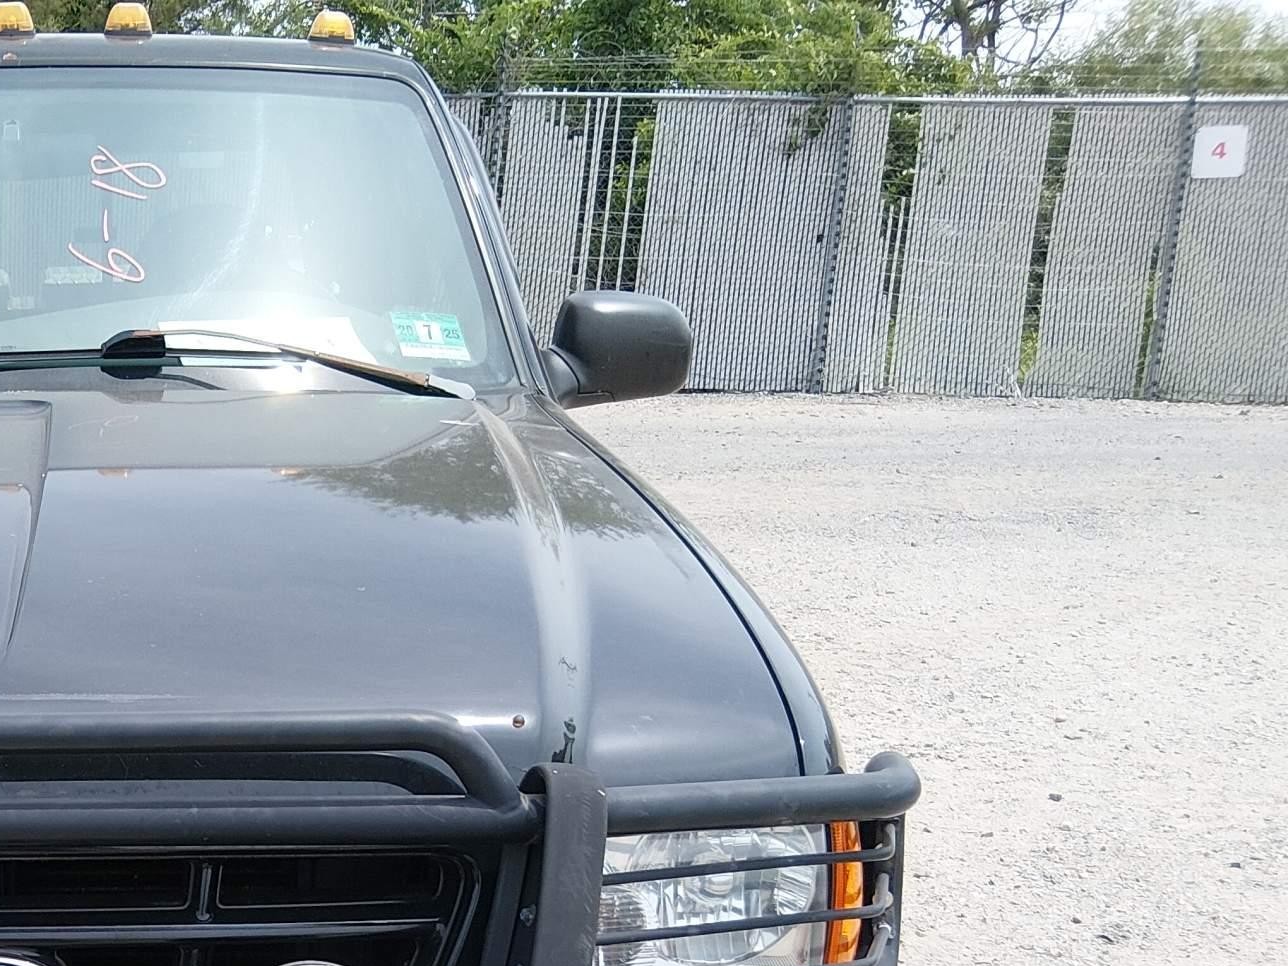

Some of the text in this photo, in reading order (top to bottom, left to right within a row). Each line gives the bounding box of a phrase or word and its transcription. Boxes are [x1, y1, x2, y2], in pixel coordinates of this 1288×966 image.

[1211, 141, 1228, 160] 4
[67, 144, 167, 283] 6-18
[422, 323, 433, 340] 7
[443, 328, 461, 340] 25
